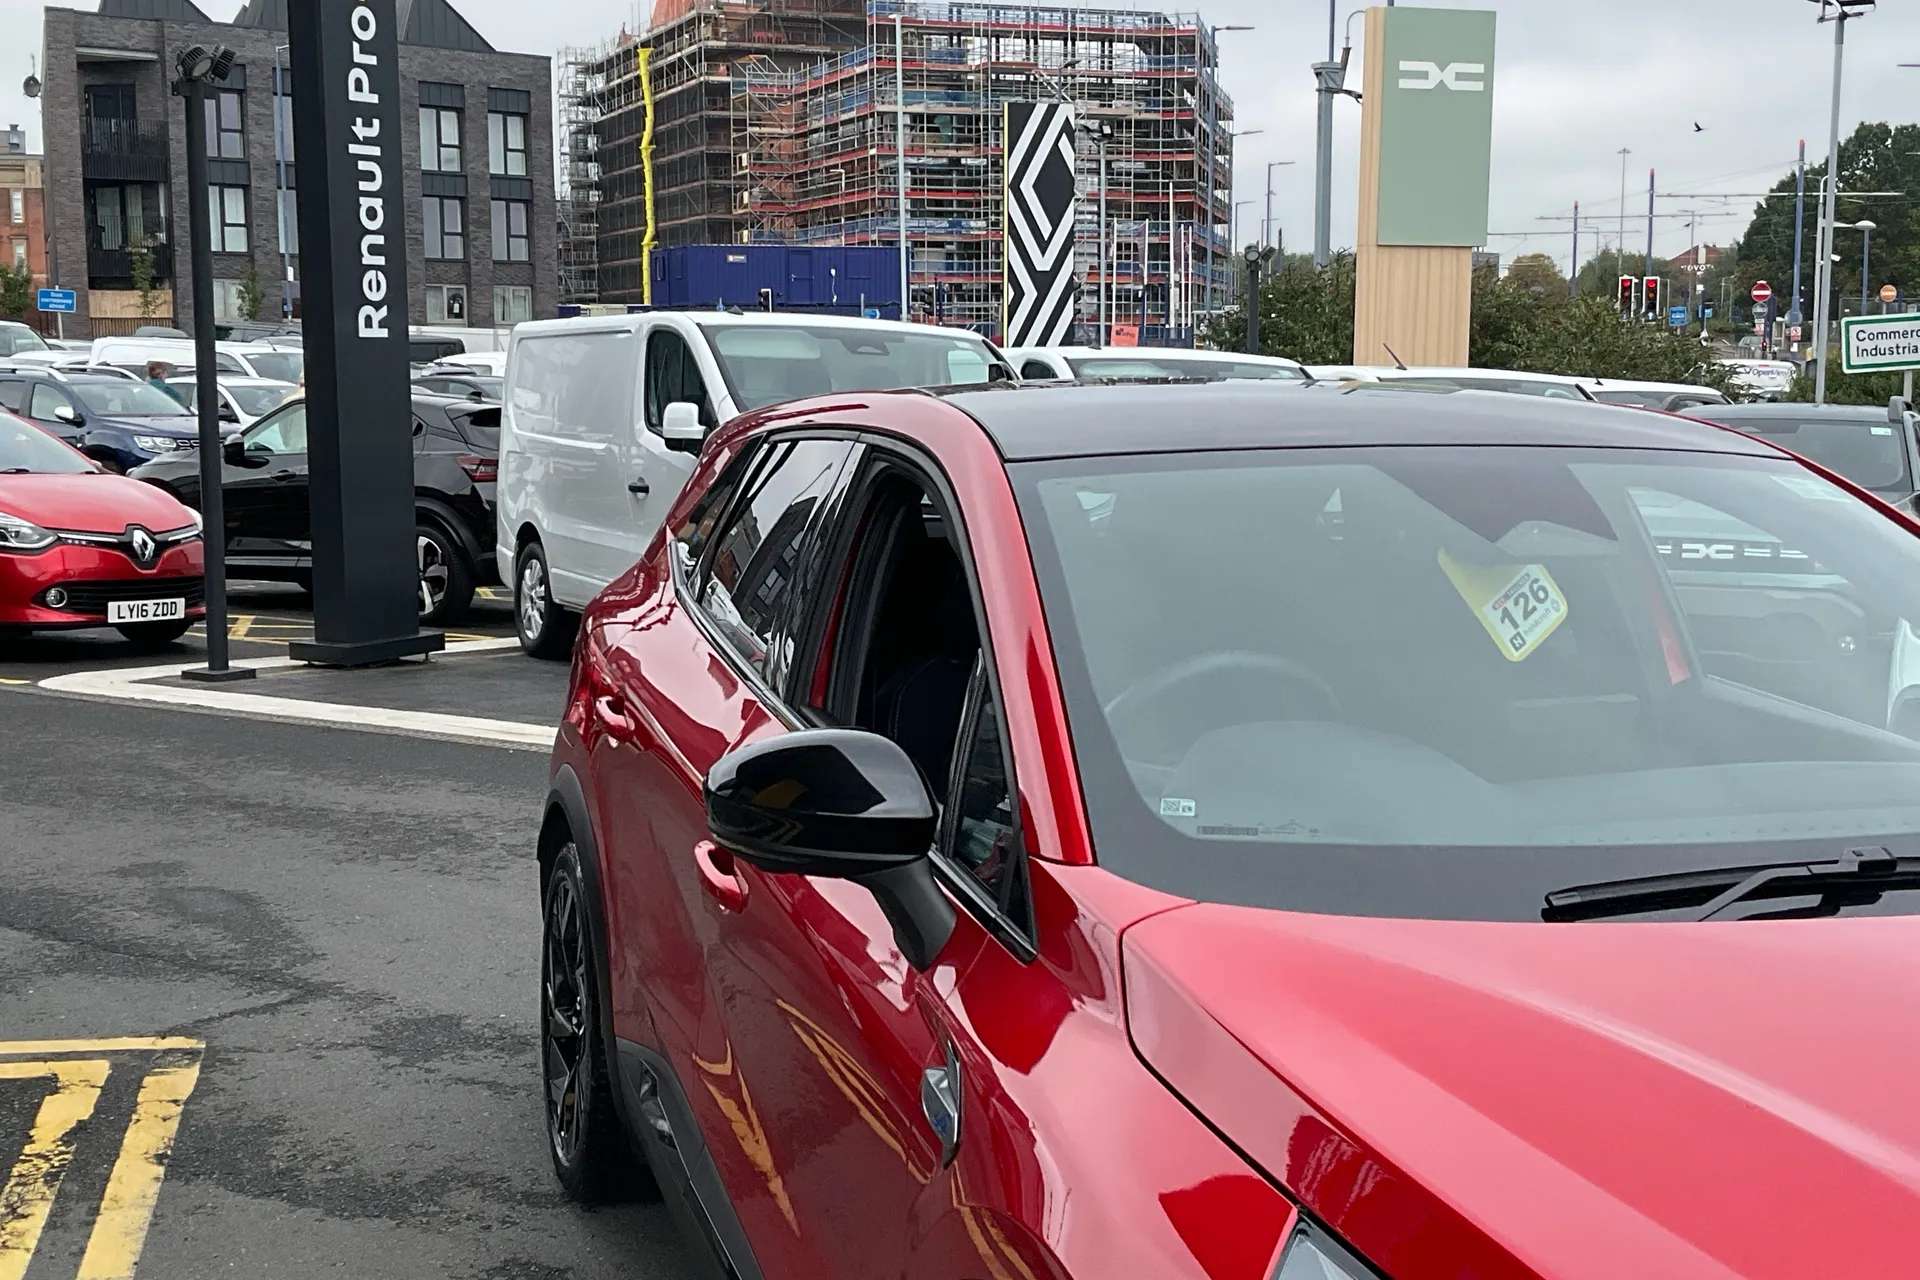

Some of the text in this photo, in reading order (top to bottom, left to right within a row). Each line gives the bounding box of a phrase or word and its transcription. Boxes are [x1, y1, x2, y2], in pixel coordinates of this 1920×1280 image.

[348, 0, 389, 338] Renault Pro
[1856, 342, 1919, 357] Industria
[117, 601, 177, 620] LY16 ZDD
[1500, 577, 1549, 630] 126
